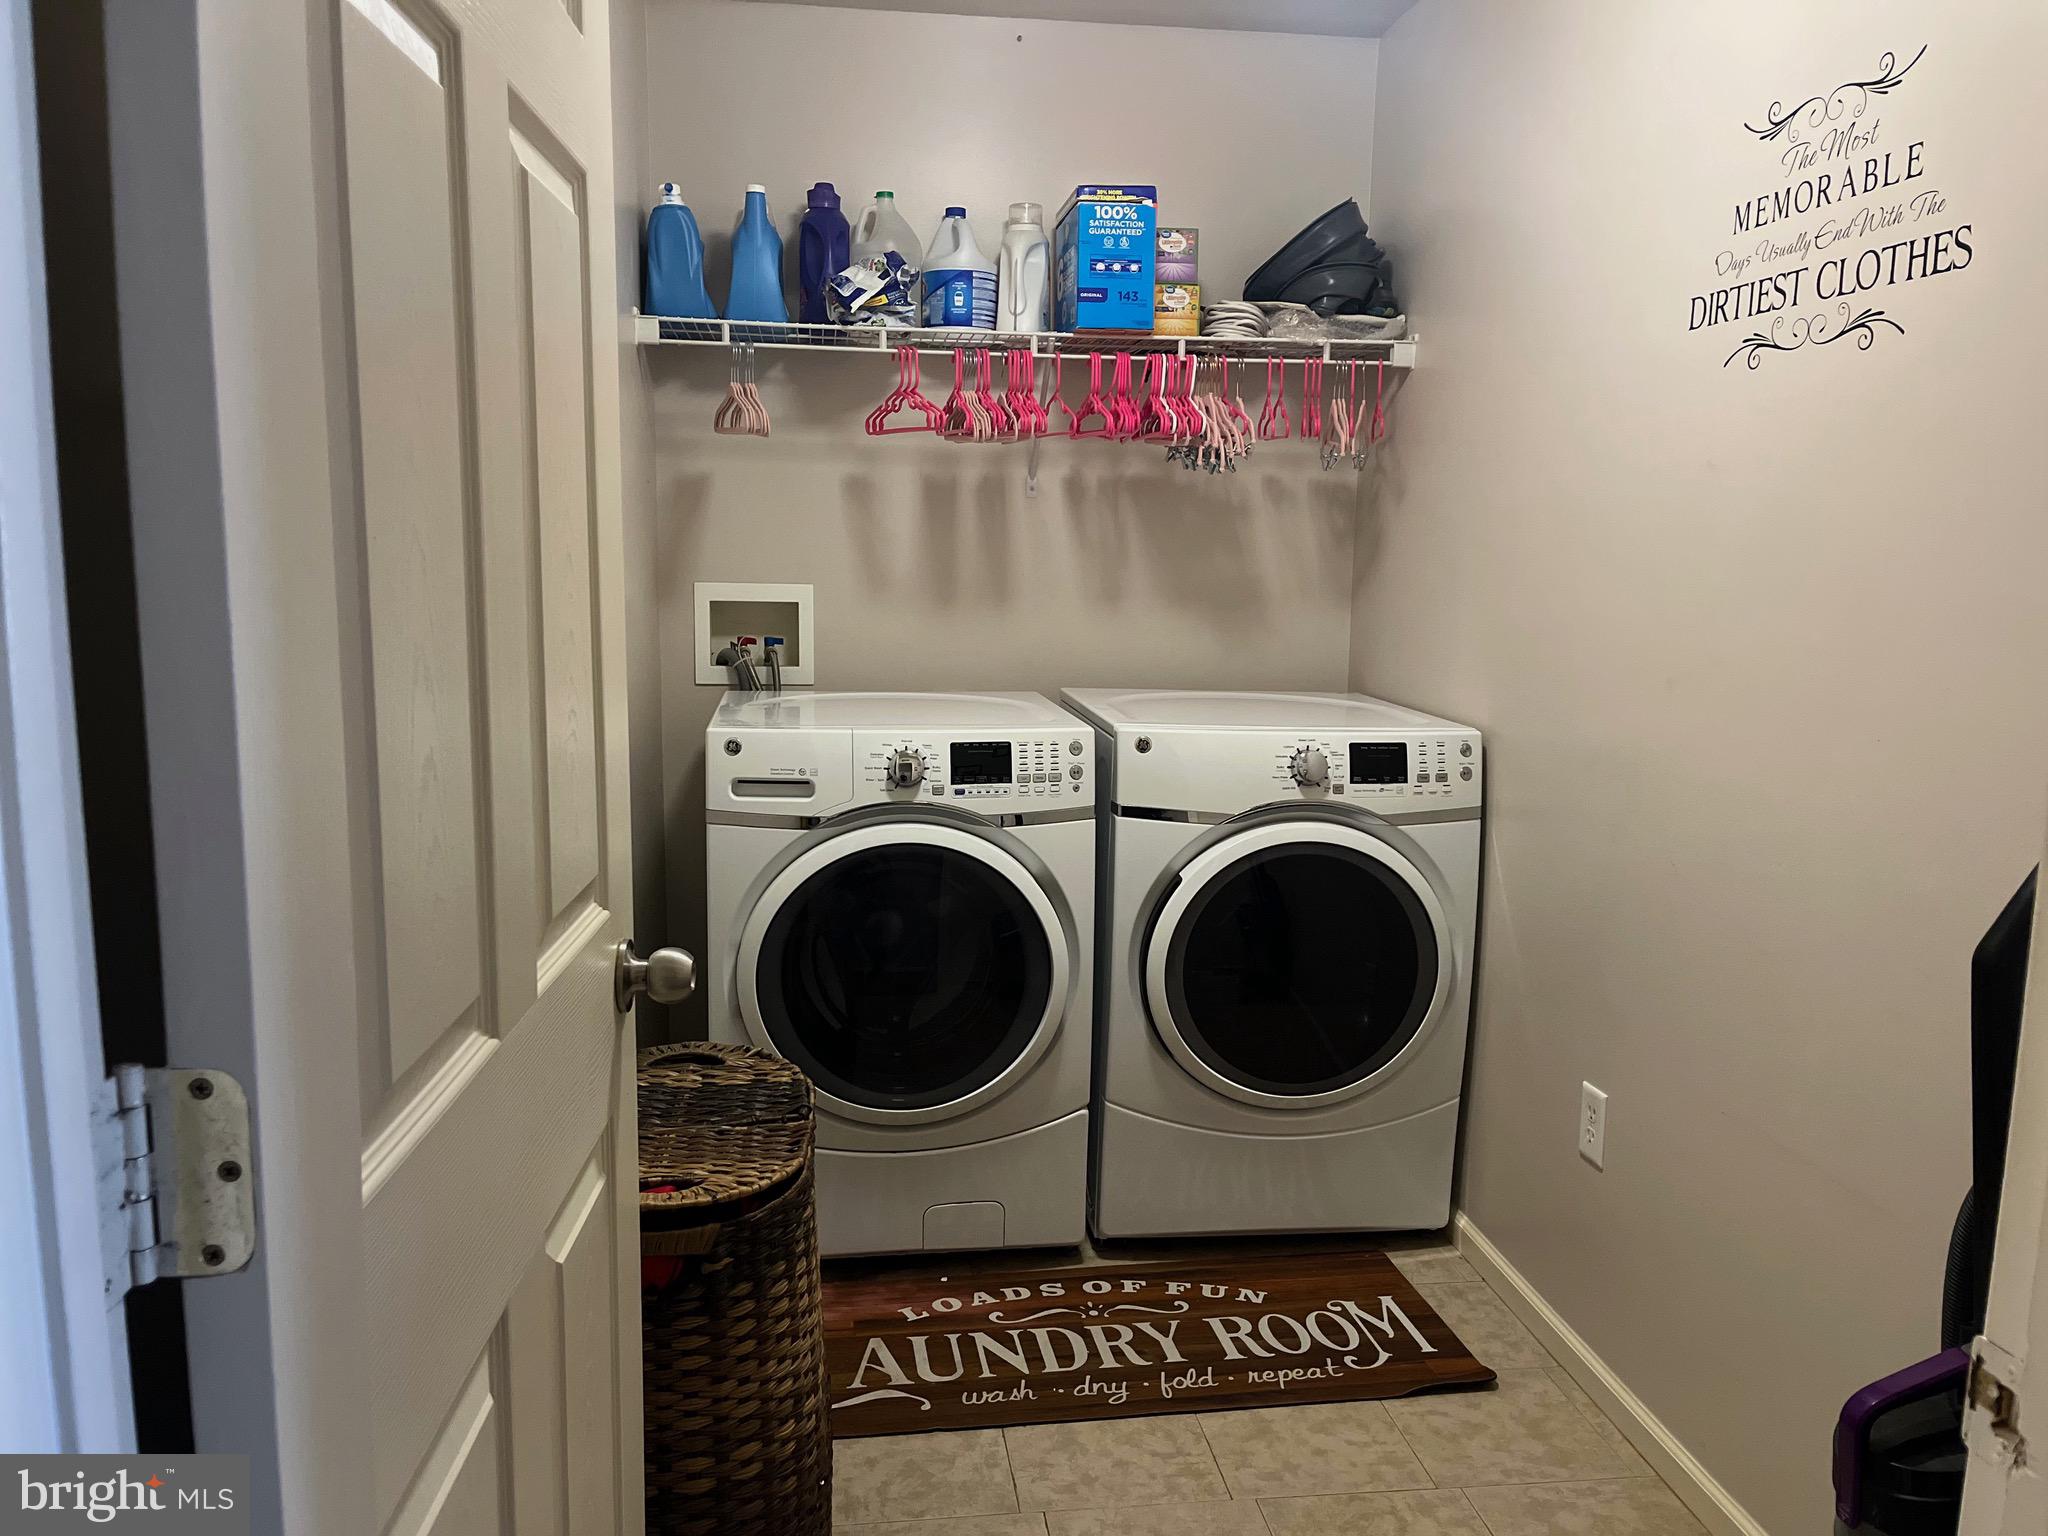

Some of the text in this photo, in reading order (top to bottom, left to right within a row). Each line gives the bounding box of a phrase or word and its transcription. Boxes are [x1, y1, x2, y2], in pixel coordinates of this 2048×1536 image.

[1782, 119, 1880, 178] The Most
[1732, 141, 1925, 235] MEMORABLE
[1088, 227, 1143, 236] GUARANTEED
[1089, 219, 1145, 228] SATISFACTION
[1094, 205, 1138, 220] 100%
[1715, 190, 1947, 279] Days Usually End With The
[1117, 290, 1139, 302] 143
[1688, 224, 1974, 331] DIRTIEST CLOTHES
[897, 1279, 1268, 1322] LOADS OF FUN
[832, 1295, 1438, 1410] AUNDRY ROOM
[961, 1357, 1345, 1405] wash dry fold repeat
